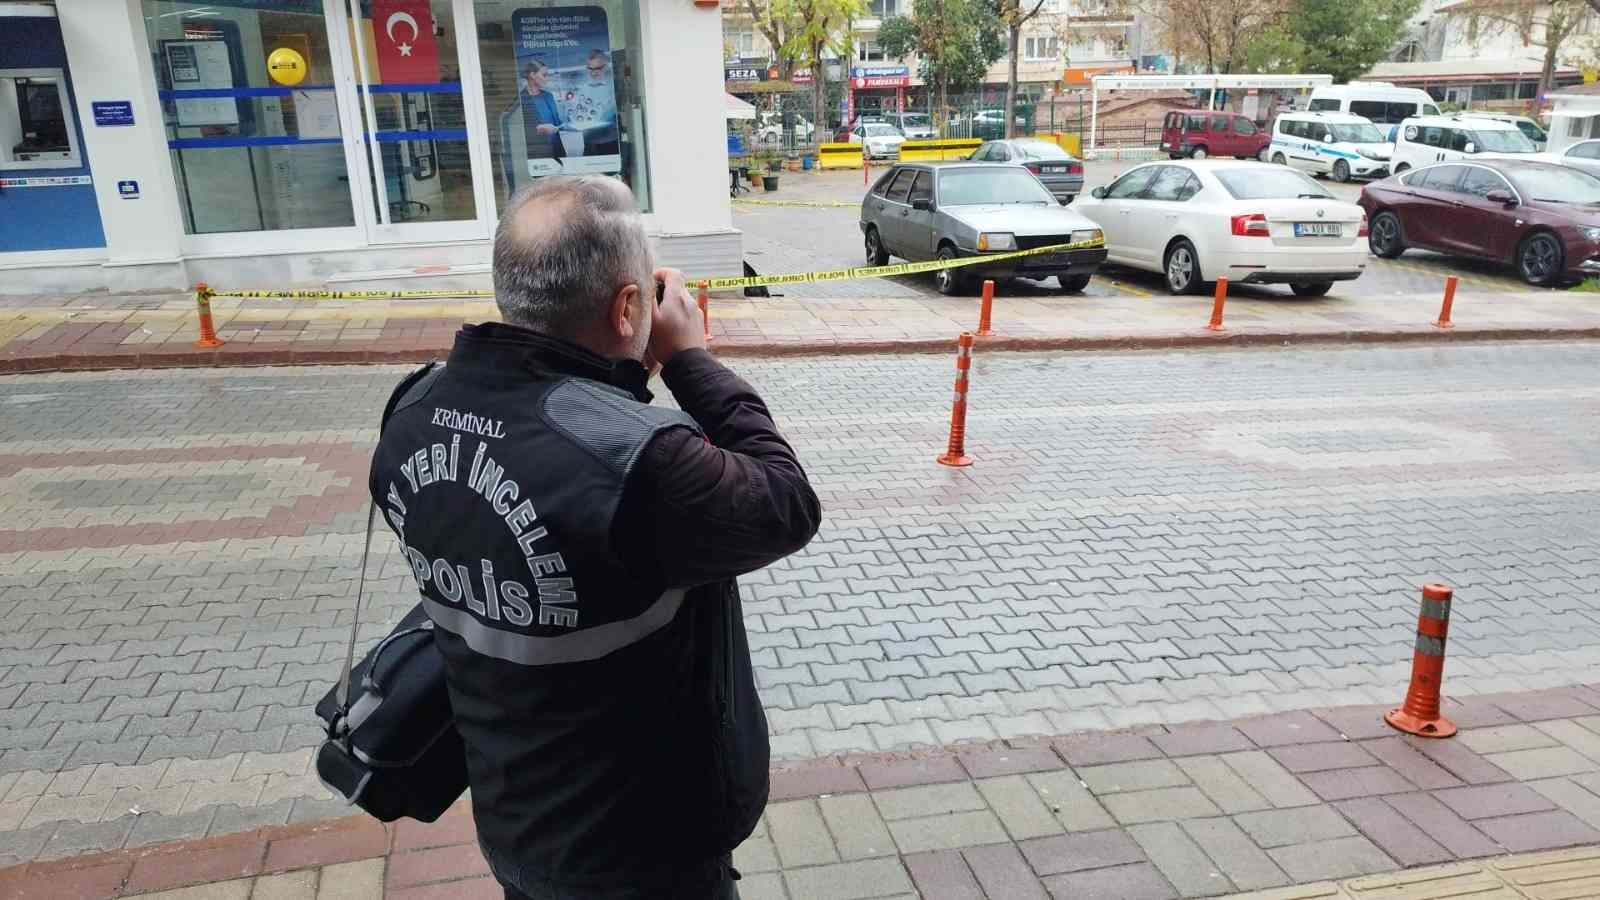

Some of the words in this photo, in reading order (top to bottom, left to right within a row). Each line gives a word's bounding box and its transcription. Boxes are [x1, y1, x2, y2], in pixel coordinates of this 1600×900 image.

[728, 69, 758, 78] SEZA
[431, 407, 506, 439] KRİMİNAL
[400, 433, 461, 494] YERİ
[467, 441, 578, 628] İNCELEME
[407, 546, 533, 627] POLİS
